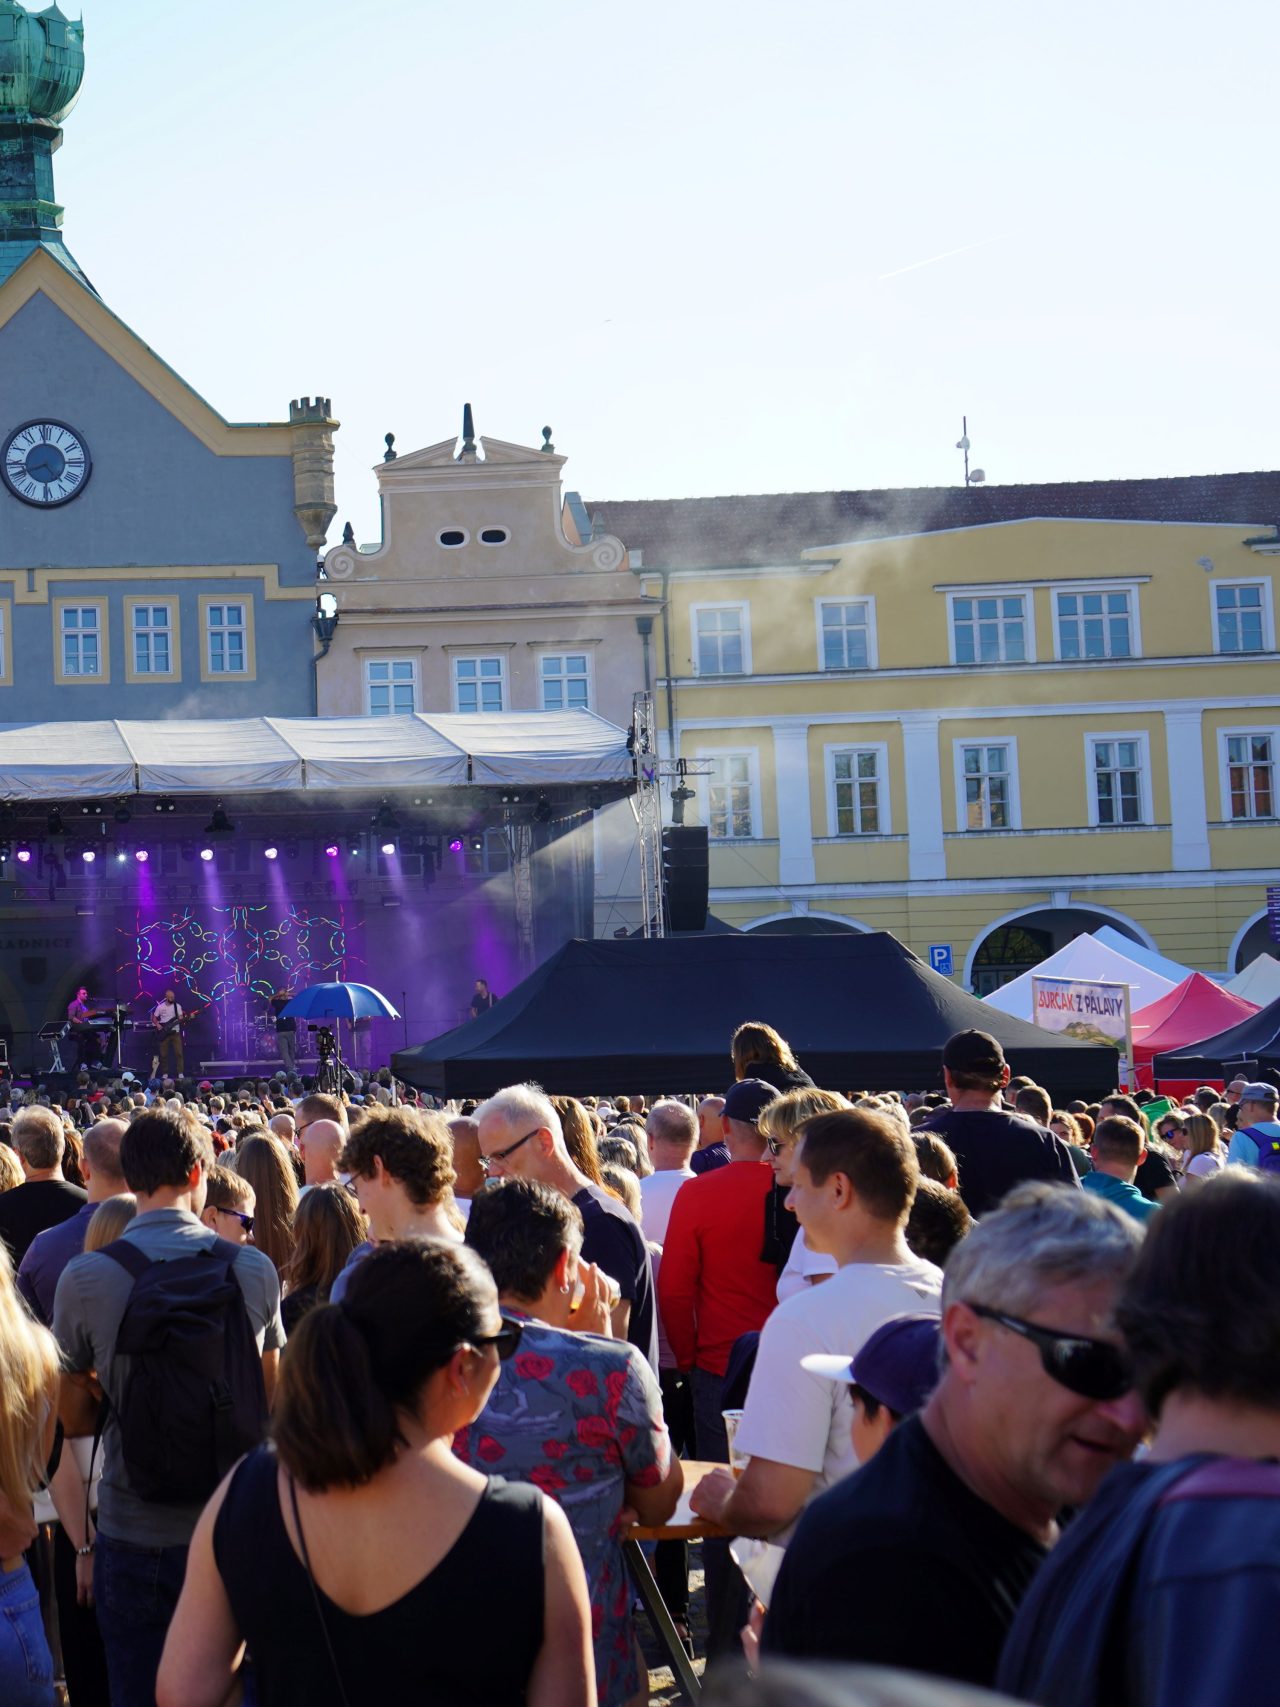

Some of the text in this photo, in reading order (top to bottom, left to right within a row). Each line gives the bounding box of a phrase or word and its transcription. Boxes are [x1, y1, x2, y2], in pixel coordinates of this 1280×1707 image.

[933, 948, 948, 967] P
[1075, 994, 1083, 1012] Z
[1084, 990, 1123, 1017] PÁLAVY
